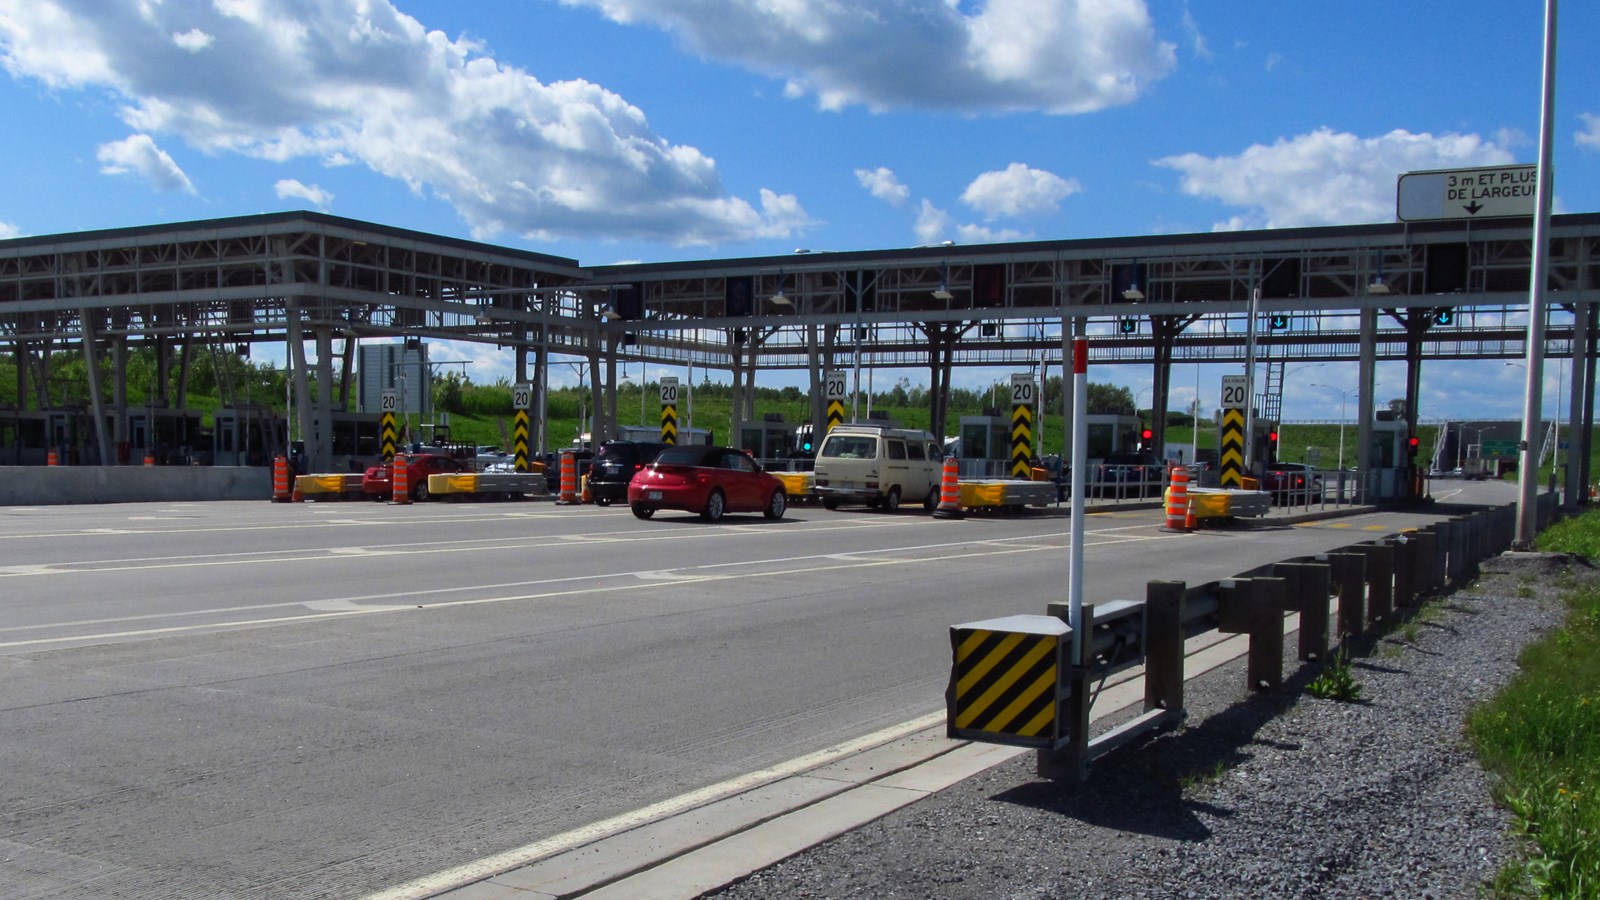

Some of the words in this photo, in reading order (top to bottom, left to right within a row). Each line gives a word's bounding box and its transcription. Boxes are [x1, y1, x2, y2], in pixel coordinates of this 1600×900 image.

[1448, 176, 1457, 187] 3
[1461, 177, 1474, 186] m
[1478, 174, 1496, 185] ET
[1448, 188, 1466, 200] DE
[662, 386, 676, 400] 20
[829, 380, 844, 395] 20
[1013, 384, 1031, 399] 20
[515, 392, 528, 405] 20
[1224, 386, 1244, 403] 20
[382, 395, 395, 408] 20
